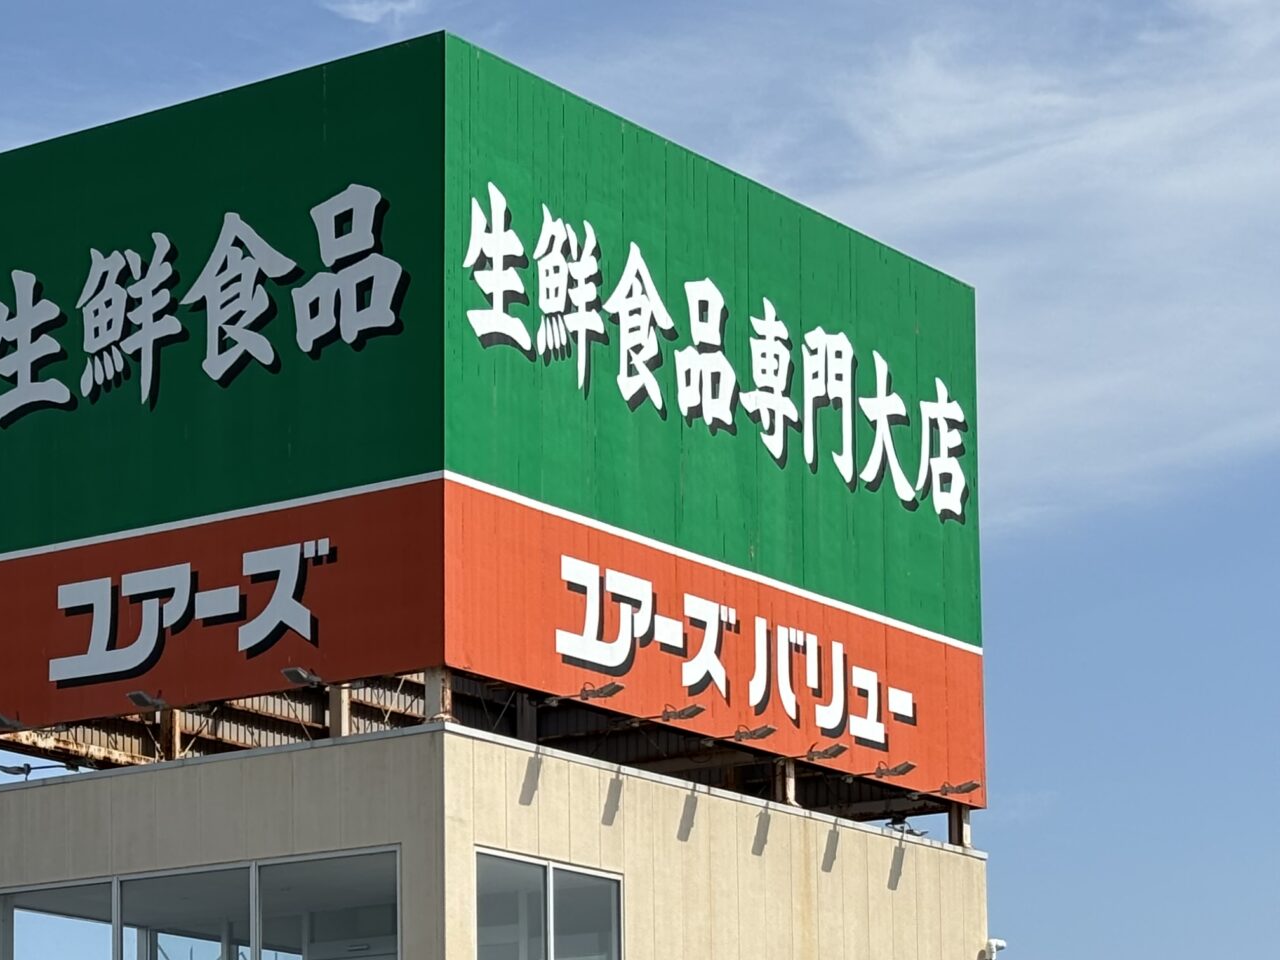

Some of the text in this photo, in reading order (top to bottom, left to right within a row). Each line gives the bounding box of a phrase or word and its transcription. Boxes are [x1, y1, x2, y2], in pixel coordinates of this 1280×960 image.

[463, 182, 965, 515] 生鮮食品専門大店
